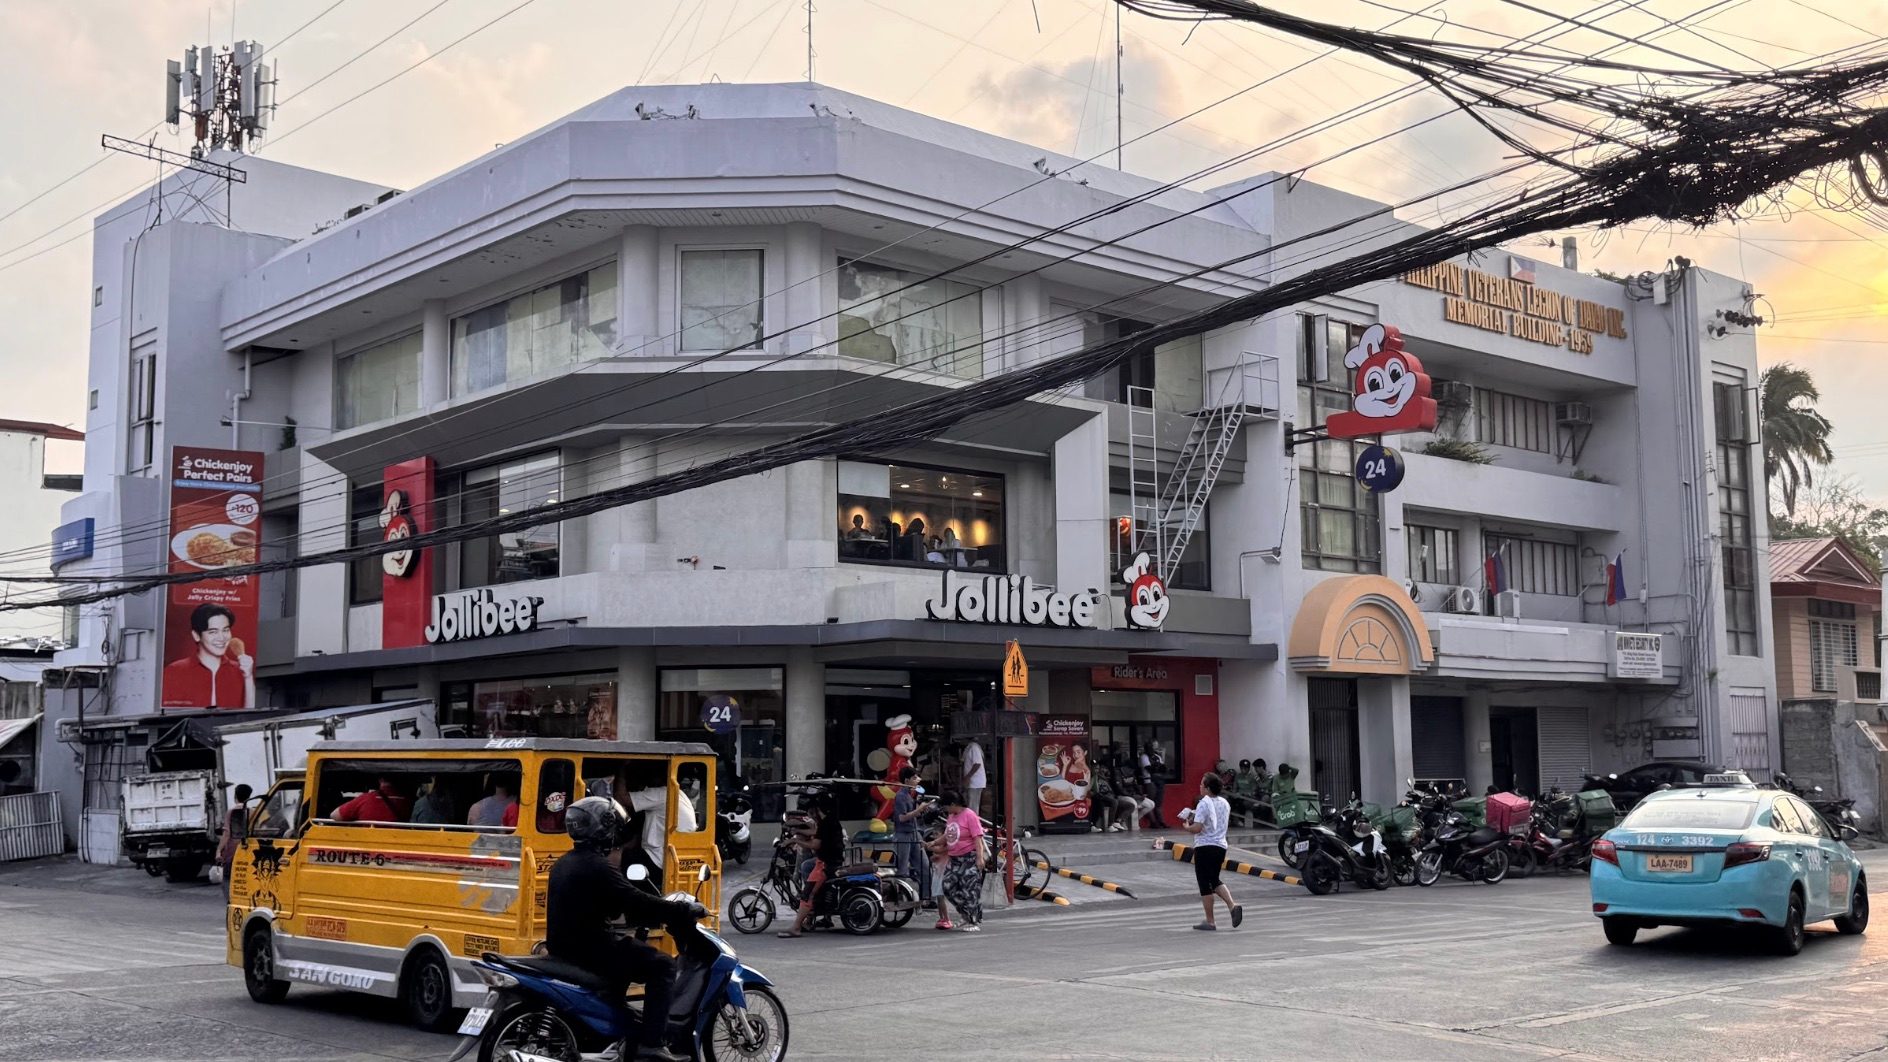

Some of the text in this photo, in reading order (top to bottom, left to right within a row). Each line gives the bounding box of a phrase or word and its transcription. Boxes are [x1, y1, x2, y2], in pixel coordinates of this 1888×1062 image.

[1467, 268, 1524, 312] VETERANS
[1526, 283, 1562, 322] LEGION
[1562, 295, 1577, 326] OF
[1579, 299, 1606, 333] DAVAO
[1444, 296, 1508, 335] MEMORIAL
[194, 458, 253, 474] Chickenjoy
[1365, 458, 1387, 480] 24
[183, 469, 252, 483] Perfect Pairs
[192, 587, 227, 596] Chickenjoy
[926, 569, 1096, 628] Jollibee
[425, 588, 534, 643] Jollibee
[1114, 665, 1168, 679] Rider's Area
[709, 706, 732, 724] 24
[1053, 720, 1084, 728] Chickenjoy
[1636, 834, 1655, 845] 124
[1681, 835, 1714, 847] 3392
[1650, 857, 1689, 869] LAA-7489
